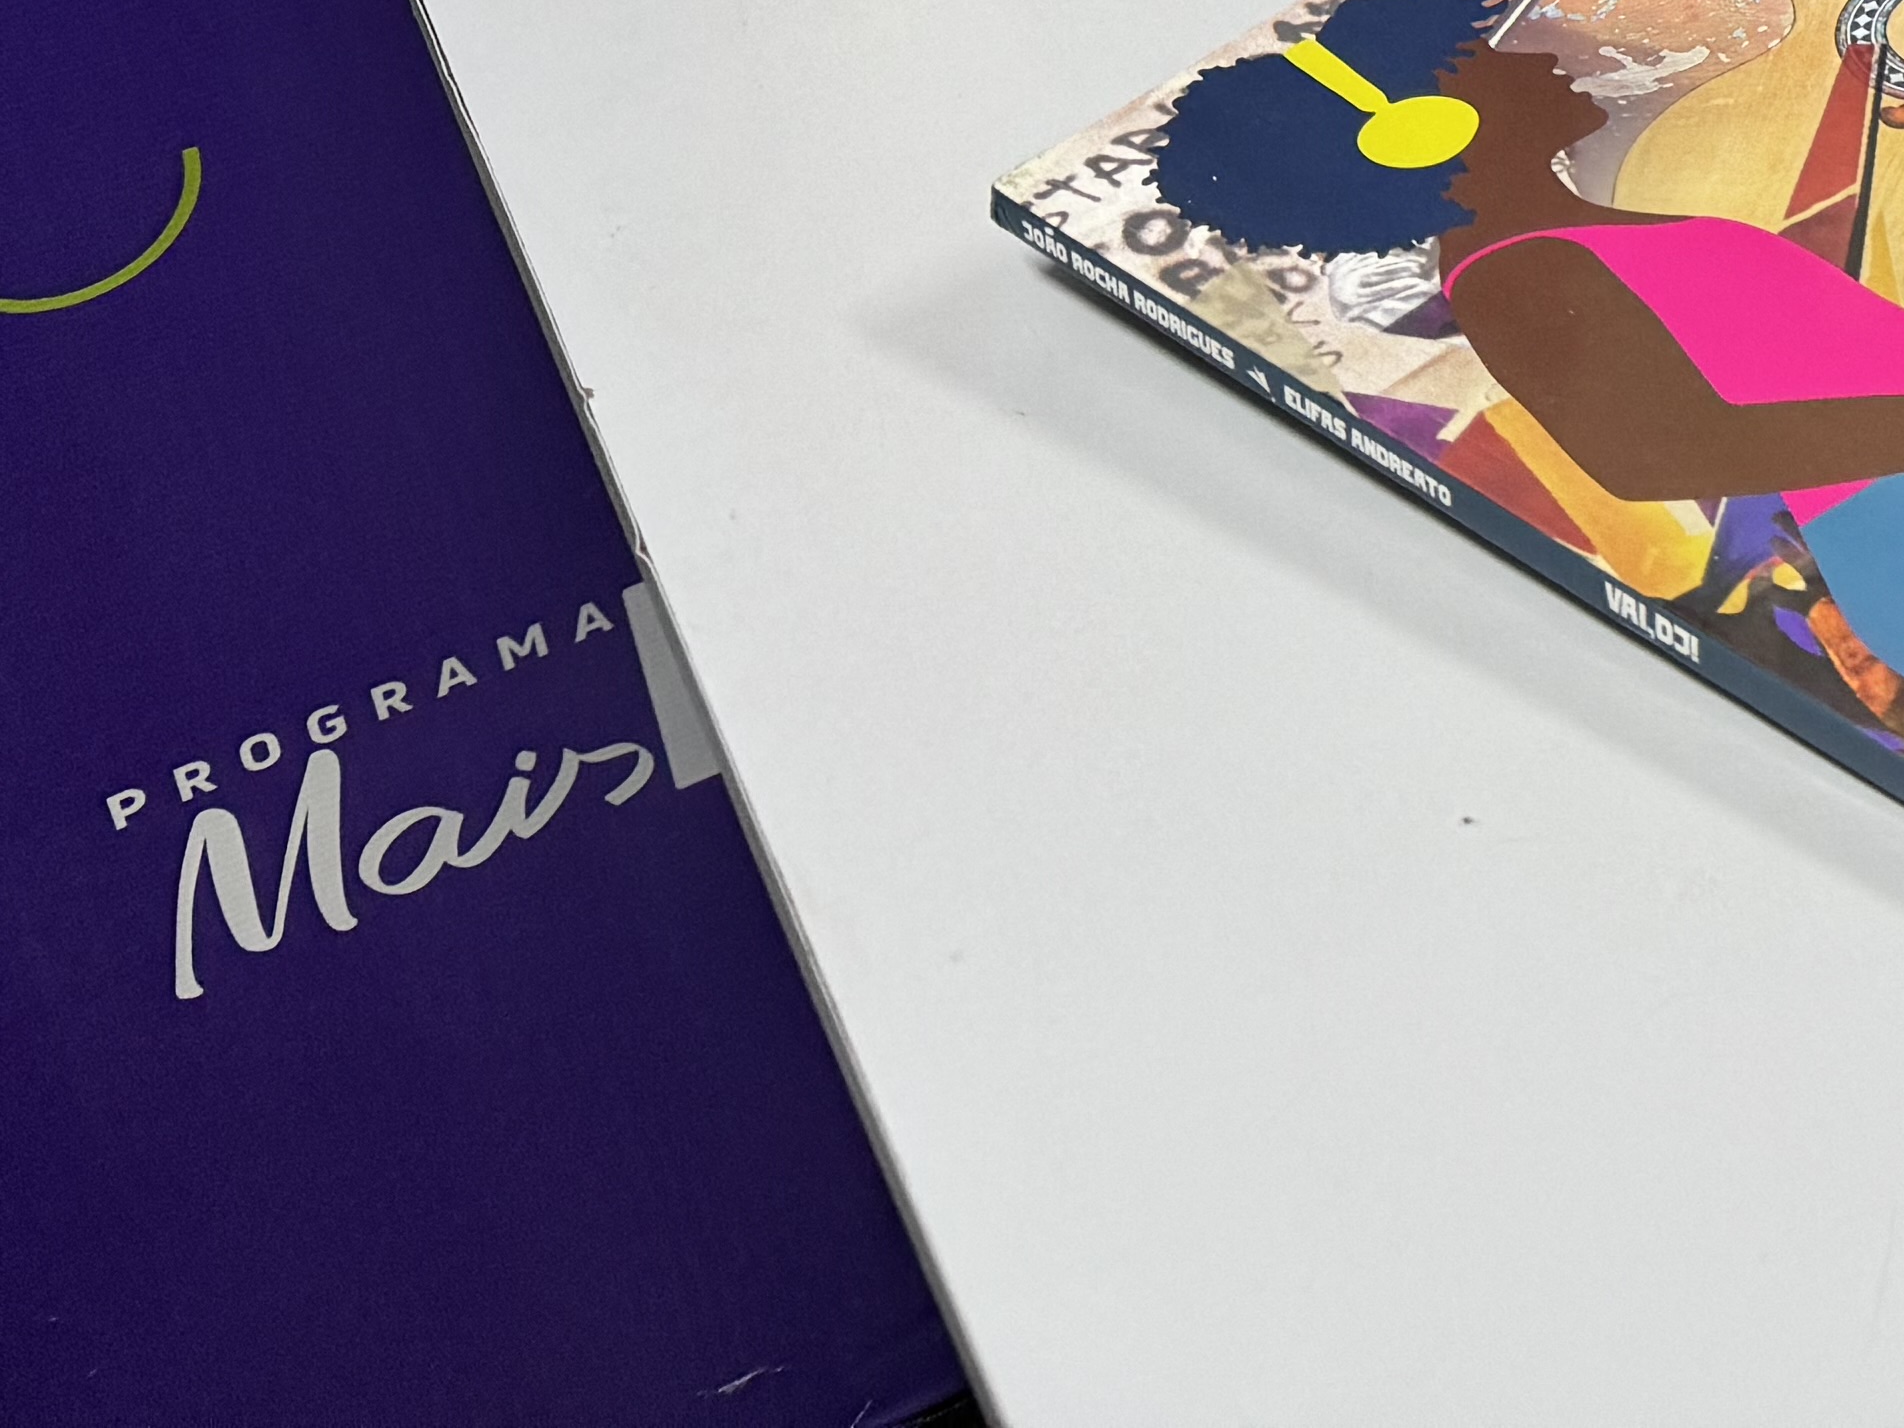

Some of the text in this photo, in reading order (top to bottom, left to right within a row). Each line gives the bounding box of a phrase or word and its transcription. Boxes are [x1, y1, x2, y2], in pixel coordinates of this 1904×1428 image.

[1020, 220, 1069, 264] JOÃO
[1071, 252, 1130, 304] ROCHA
[1134, 289, 1234, 371] RODRIGUES
[1284, 385, 1347, 440] ELIFAS
[1350, 425, 1452, 507] ANDREATO
[105, 601, 614, 830] PROGRAMA
[174, 741, 654, 999] Mais
